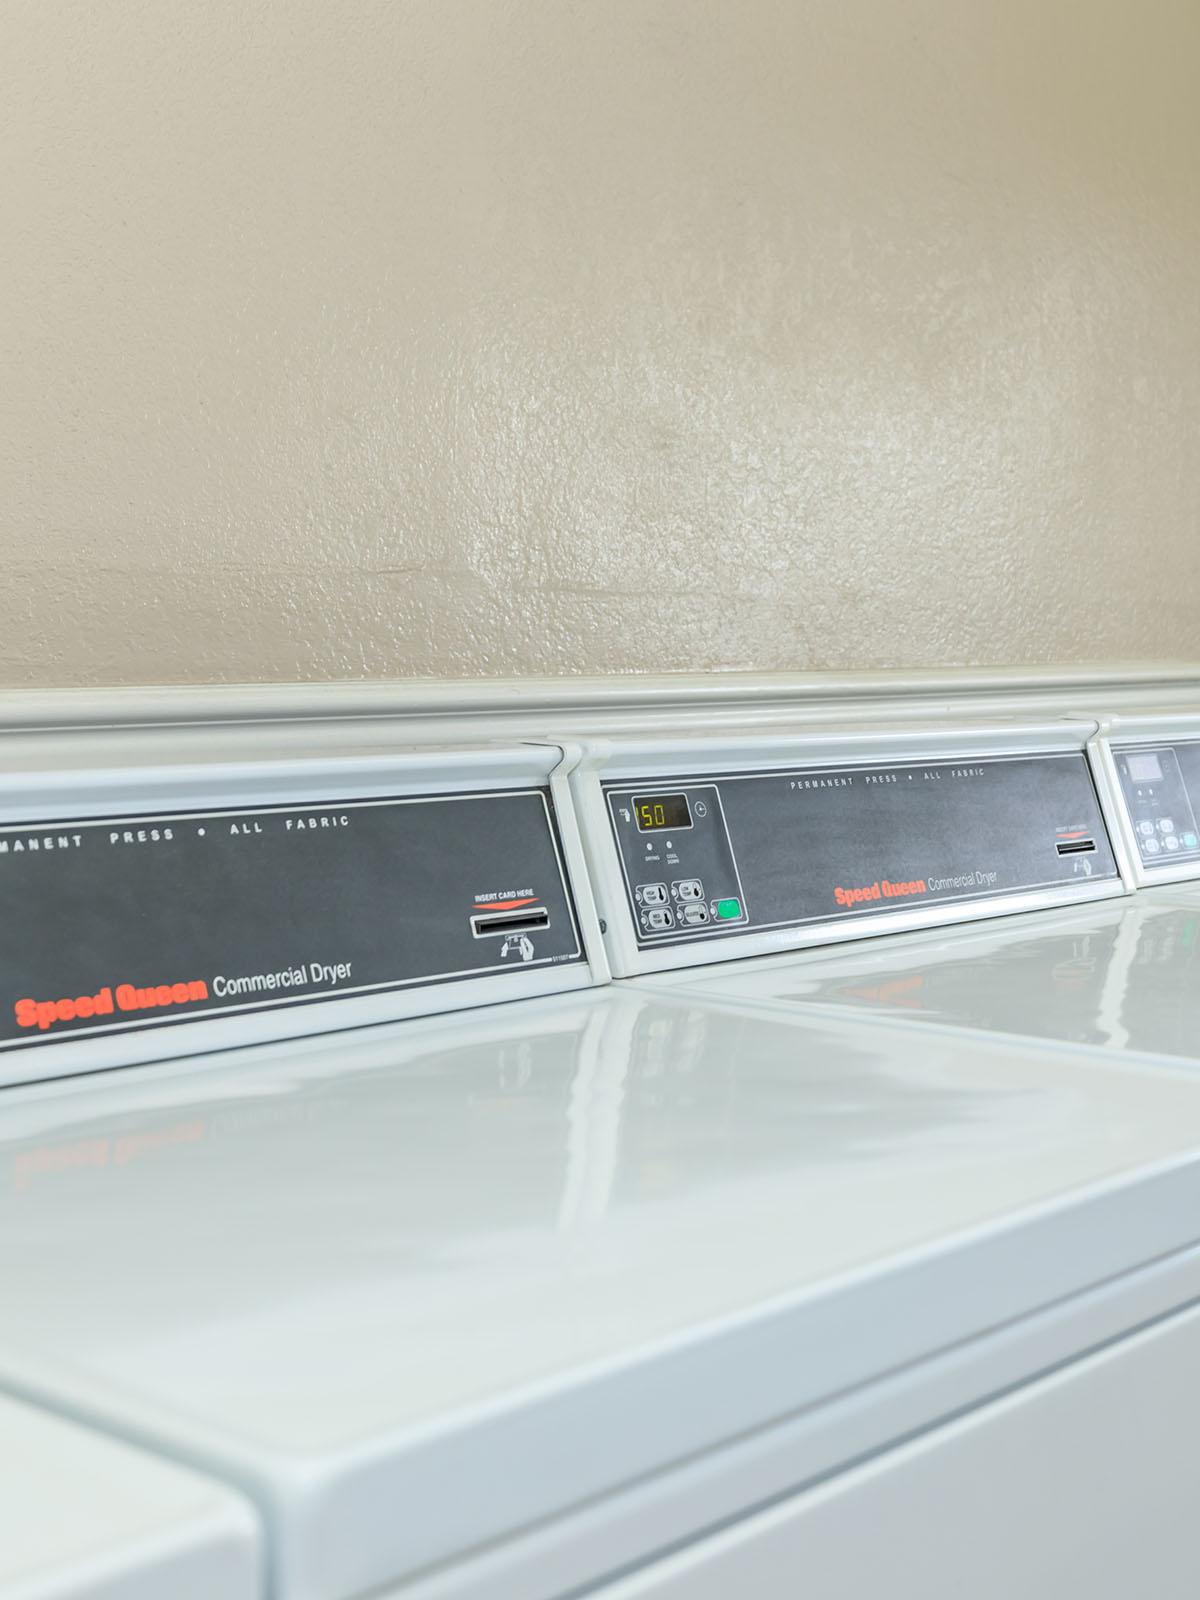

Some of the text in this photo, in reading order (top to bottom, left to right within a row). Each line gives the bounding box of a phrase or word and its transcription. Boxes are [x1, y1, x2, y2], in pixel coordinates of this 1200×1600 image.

[790, 768, 985, 790] PERMANENT PRESS ALL FABRIC
[109, 828, 174, 844] PRESS
[230, 821, 263, 835] ALL
[285, 815, 350, 831] FABRIC
[474, 888, 535, 903] INSERT CARD HERE
[834, 870, 998, 908] Speed Queen Commercial Dryer
[15, 961, 352, 1030] Speed Queen Commercial Dryer
